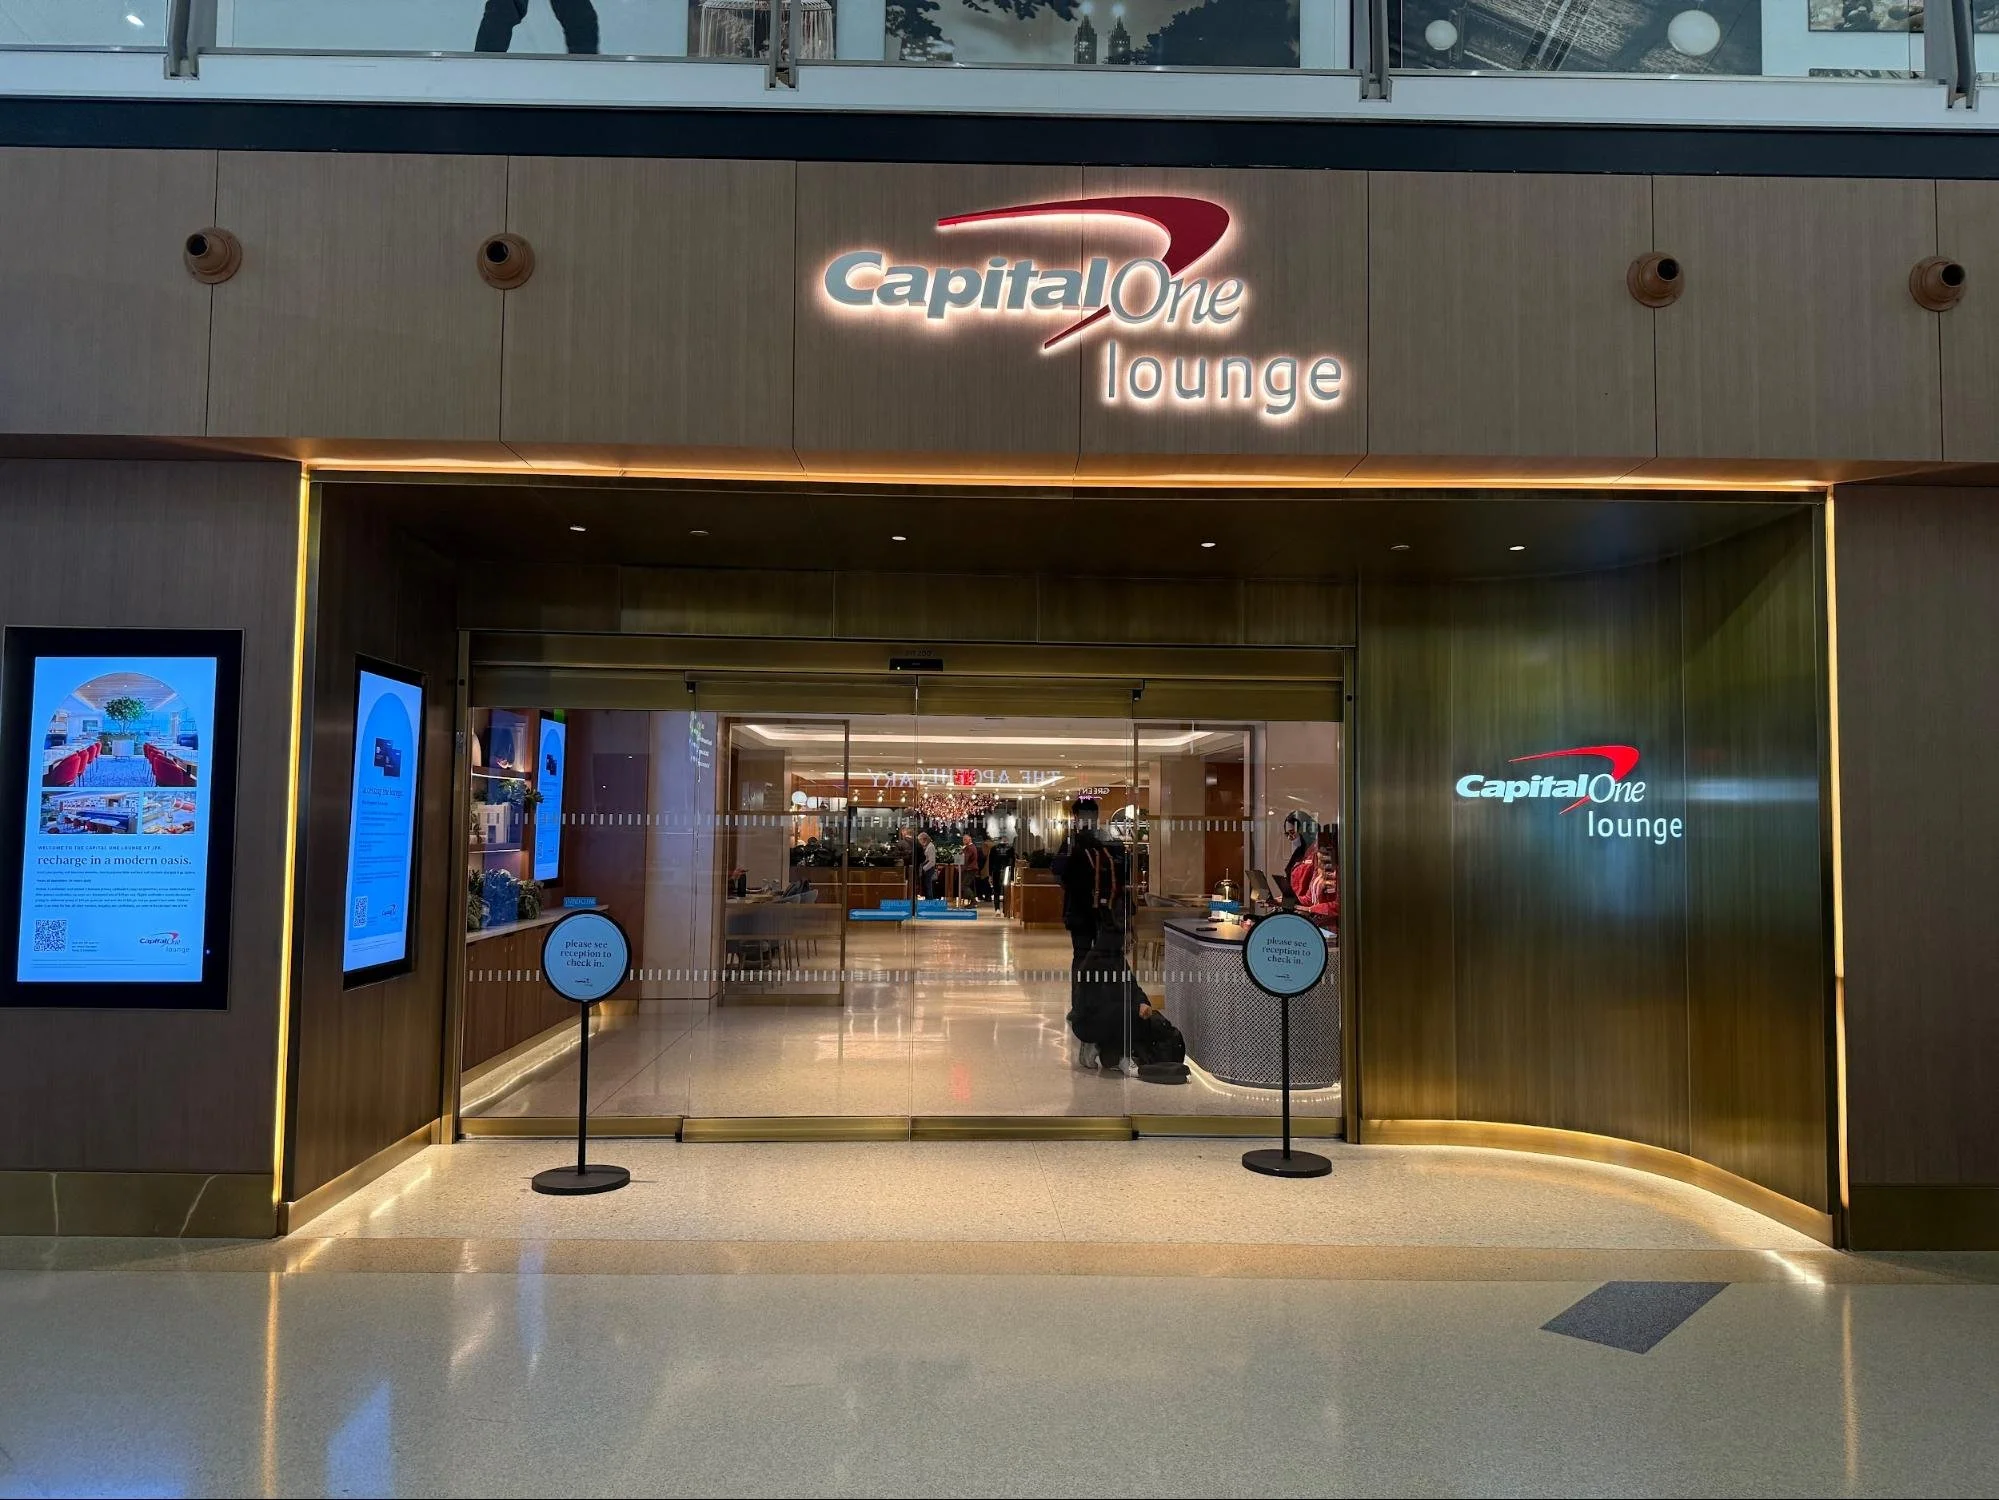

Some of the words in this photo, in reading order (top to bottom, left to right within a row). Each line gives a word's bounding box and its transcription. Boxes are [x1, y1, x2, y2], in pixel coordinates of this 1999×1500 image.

[1107, 340, 1343, 414] lounge
[1588, 811, 1683, 845] lounge
[37, 855, 88, 867] recharge
[90, 855, 101, 865] in
[104, 857, 112, 865] a
[113, 855, 157, 865] modern
[160, 855, 192, 865] oasis.
[565, 940, 592, 949] please
[594, 941, 608, 949] see
[1266, 937, 1292, 946] please
[1294, 940, 1308, 948] see
[560, 950, 601, 959] reception
[602, 951, 612, 959] to
[1261, 946, 1300, 956] reception
[1302, 949, 1311, 957] to
[566, 958, 591, 967] check
[593, 959, 605, 968] in.
[1267, 955, 1292, 964] check
